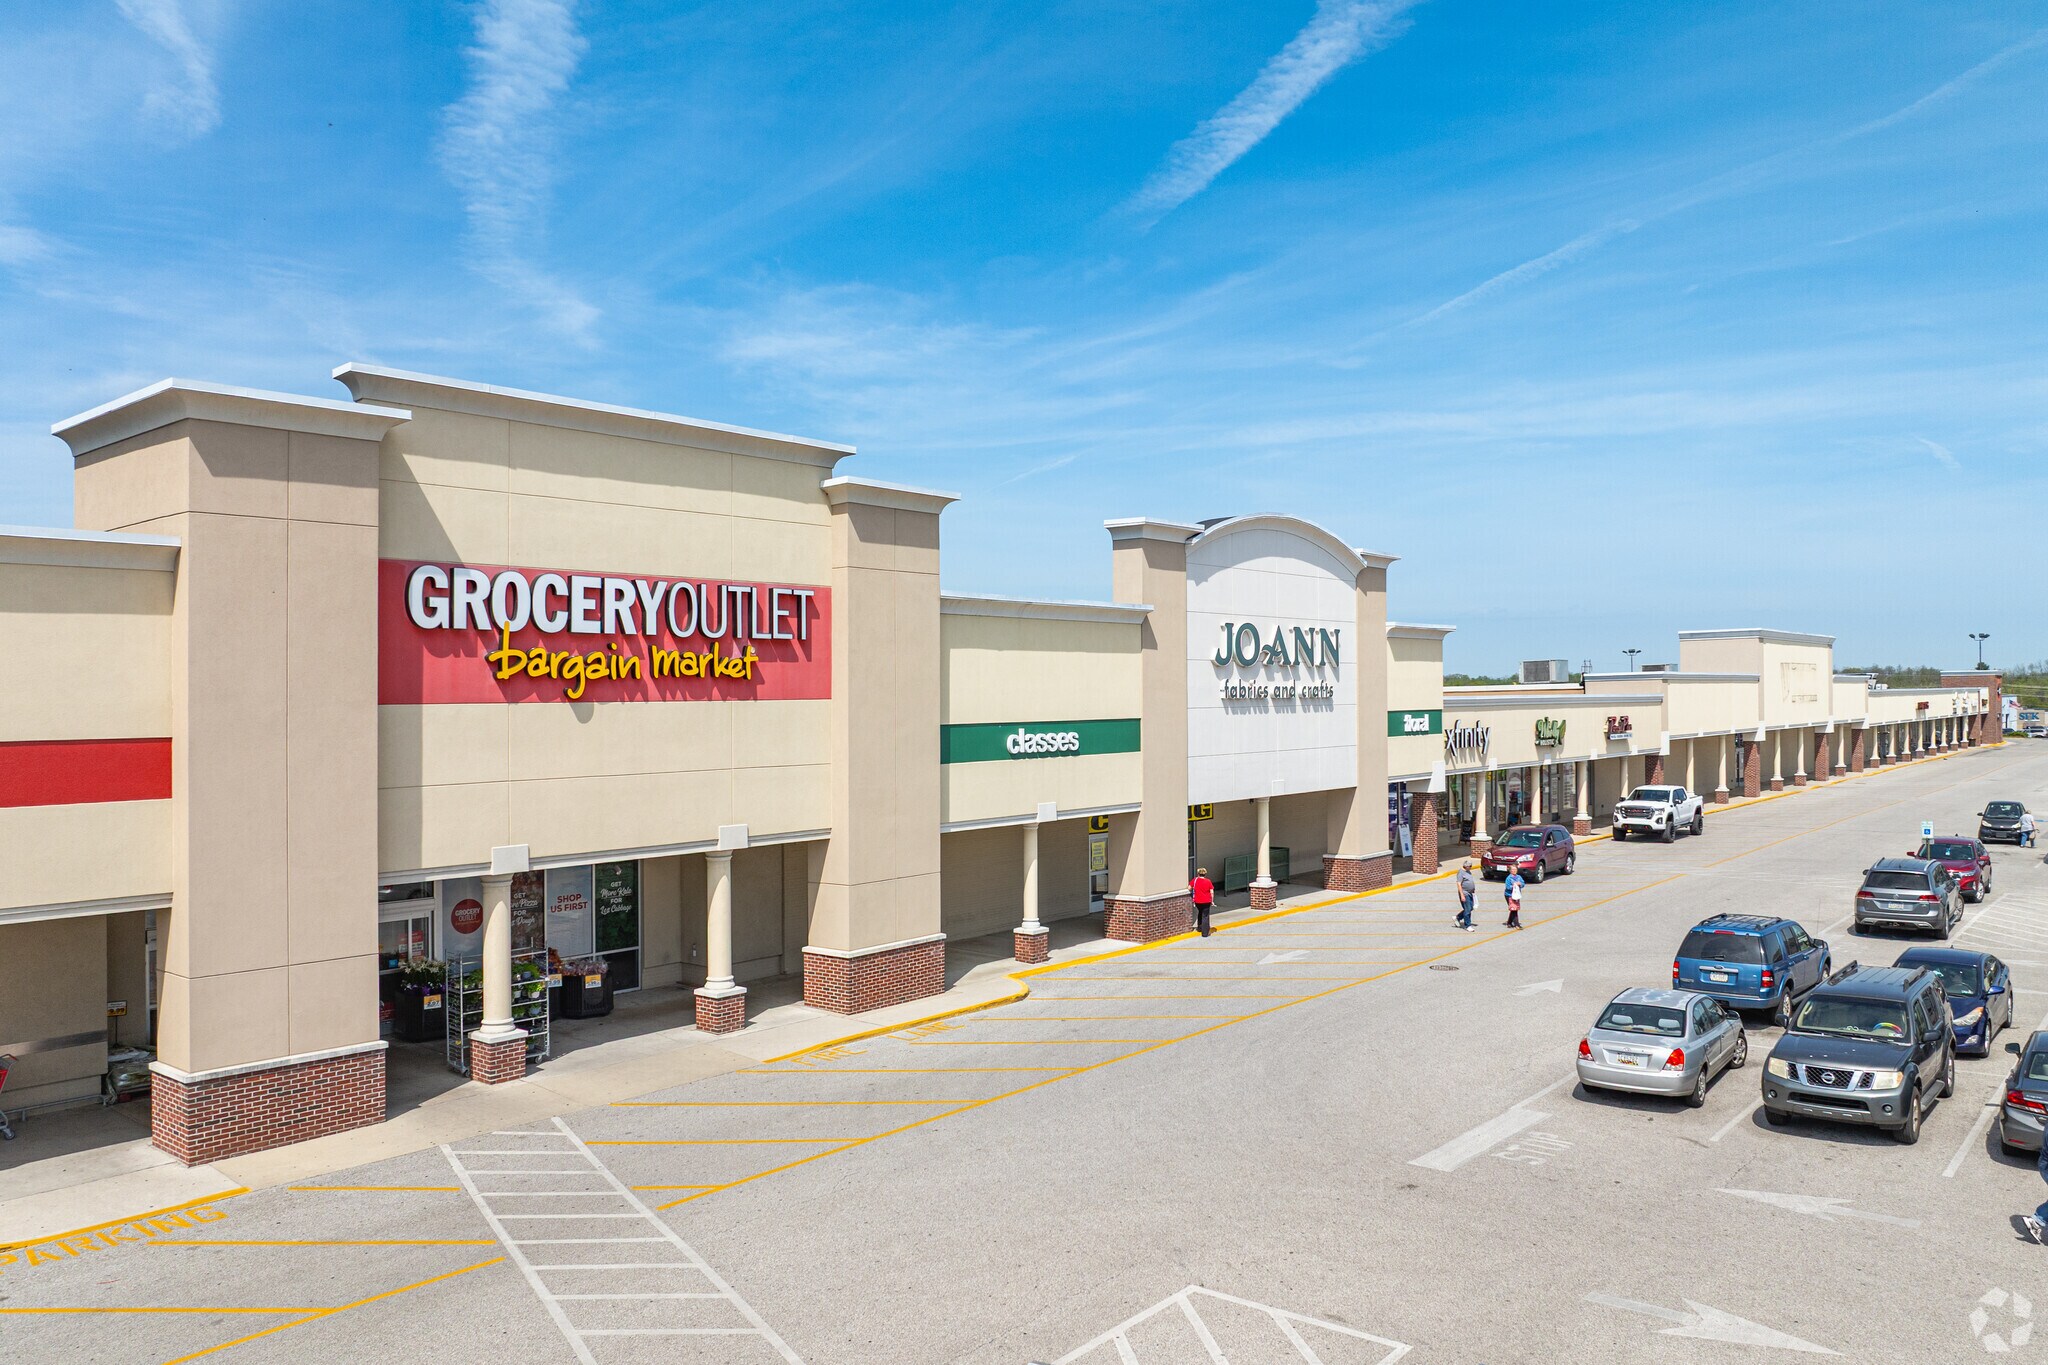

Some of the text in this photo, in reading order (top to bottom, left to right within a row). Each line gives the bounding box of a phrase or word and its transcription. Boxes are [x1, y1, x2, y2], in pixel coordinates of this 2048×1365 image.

[488, 621, 759, 700] bargain market
[1220, 679, 1334, 699] fabrics and crafts
[1403, 713, 1429, 732] floral
[1007, 728, 1080, 754] classes
[1445, 719, 1490, 757] xfinity
[550, 902, 588, 913] US FIRST
[557, 894, 582, 903] SHOP
